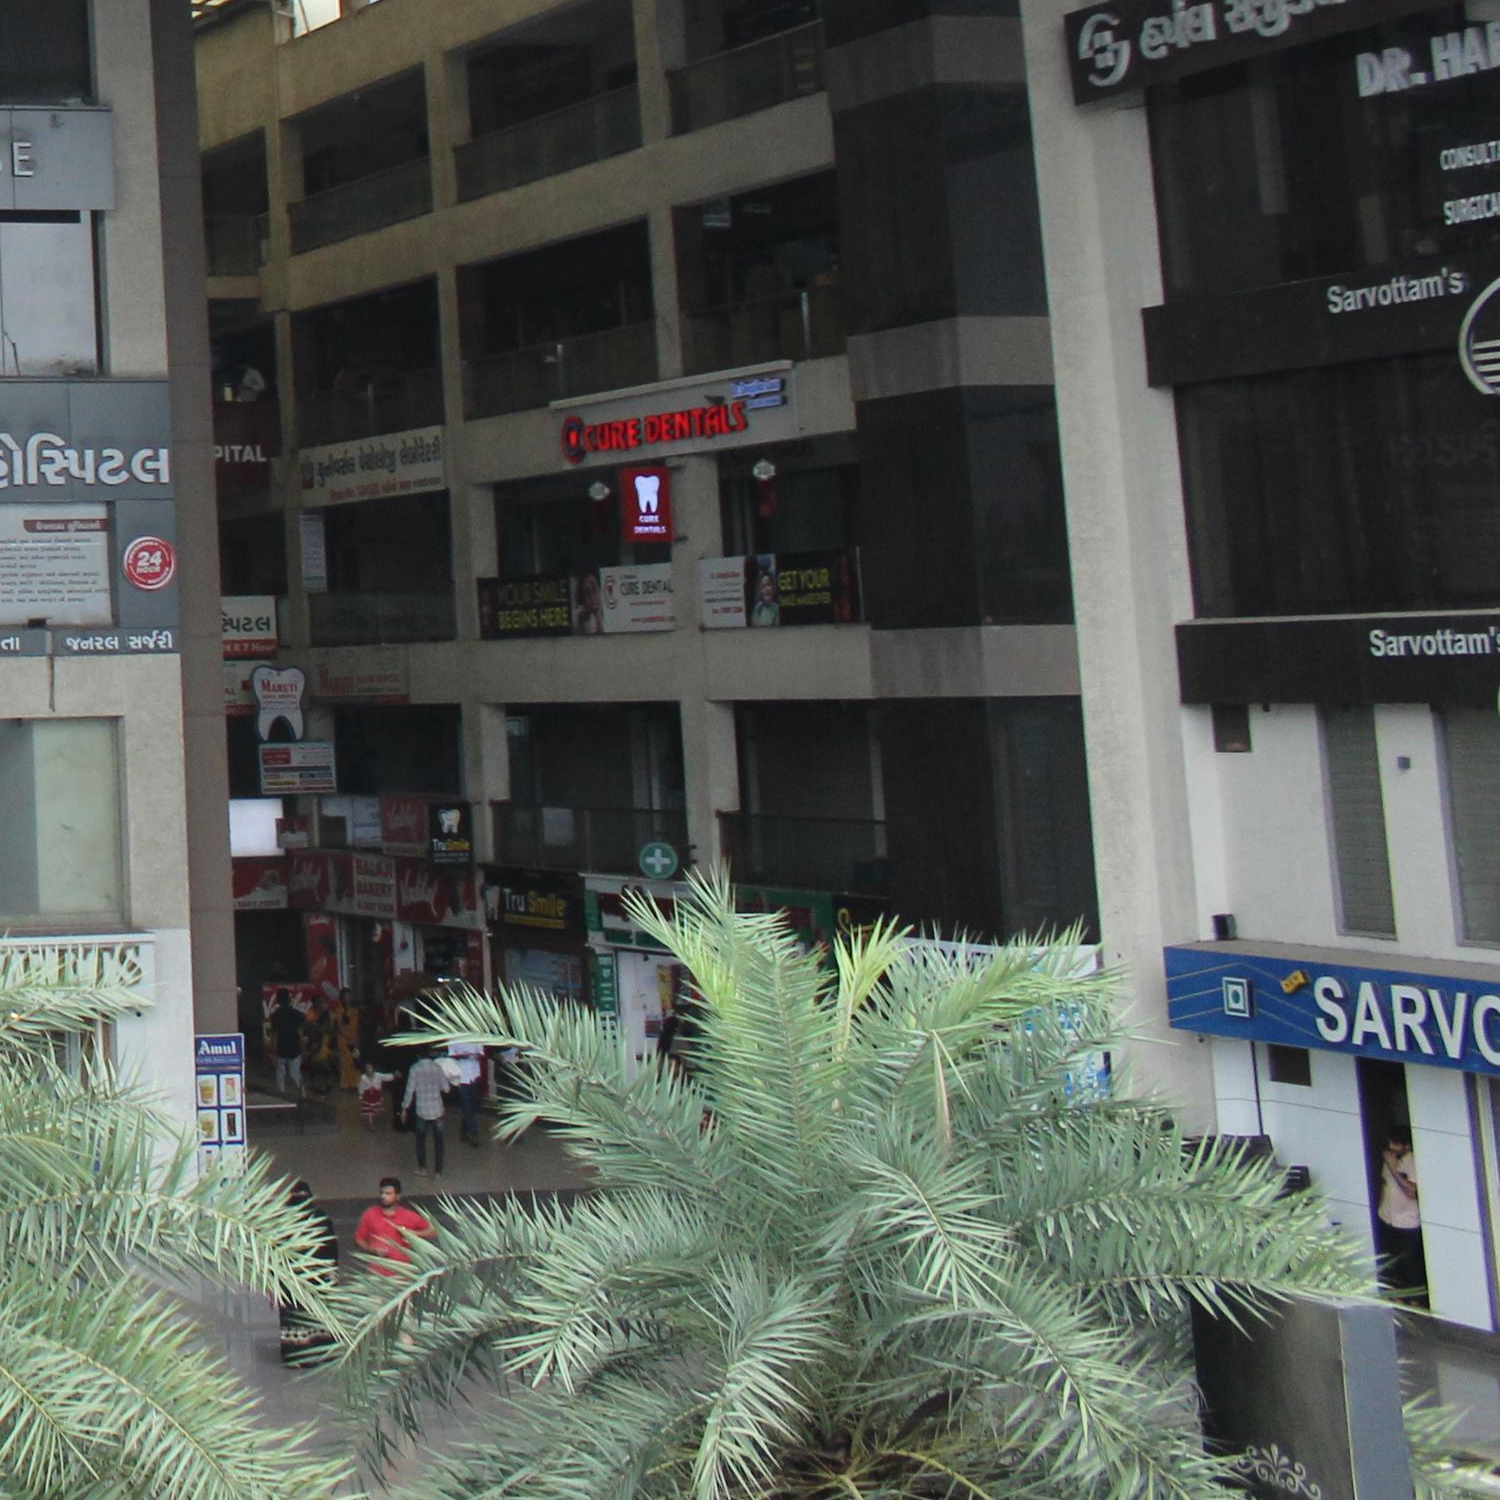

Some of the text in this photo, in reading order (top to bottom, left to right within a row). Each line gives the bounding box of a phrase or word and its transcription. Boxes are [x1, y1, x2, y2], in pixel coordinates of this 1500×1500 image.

[1356, 49, 1425, 98] DR.
[1327, 267, 1464, 314] Sarvottam's
[583, 401, 747, 451] CURE DENTALS
[138, 551, 162, 566] 24
[65, 631, 173, 652] જનરલ સર્જરી
[261, 680, 298, 693] MARUTI
[199, 1039, 237, 1057] Amul
